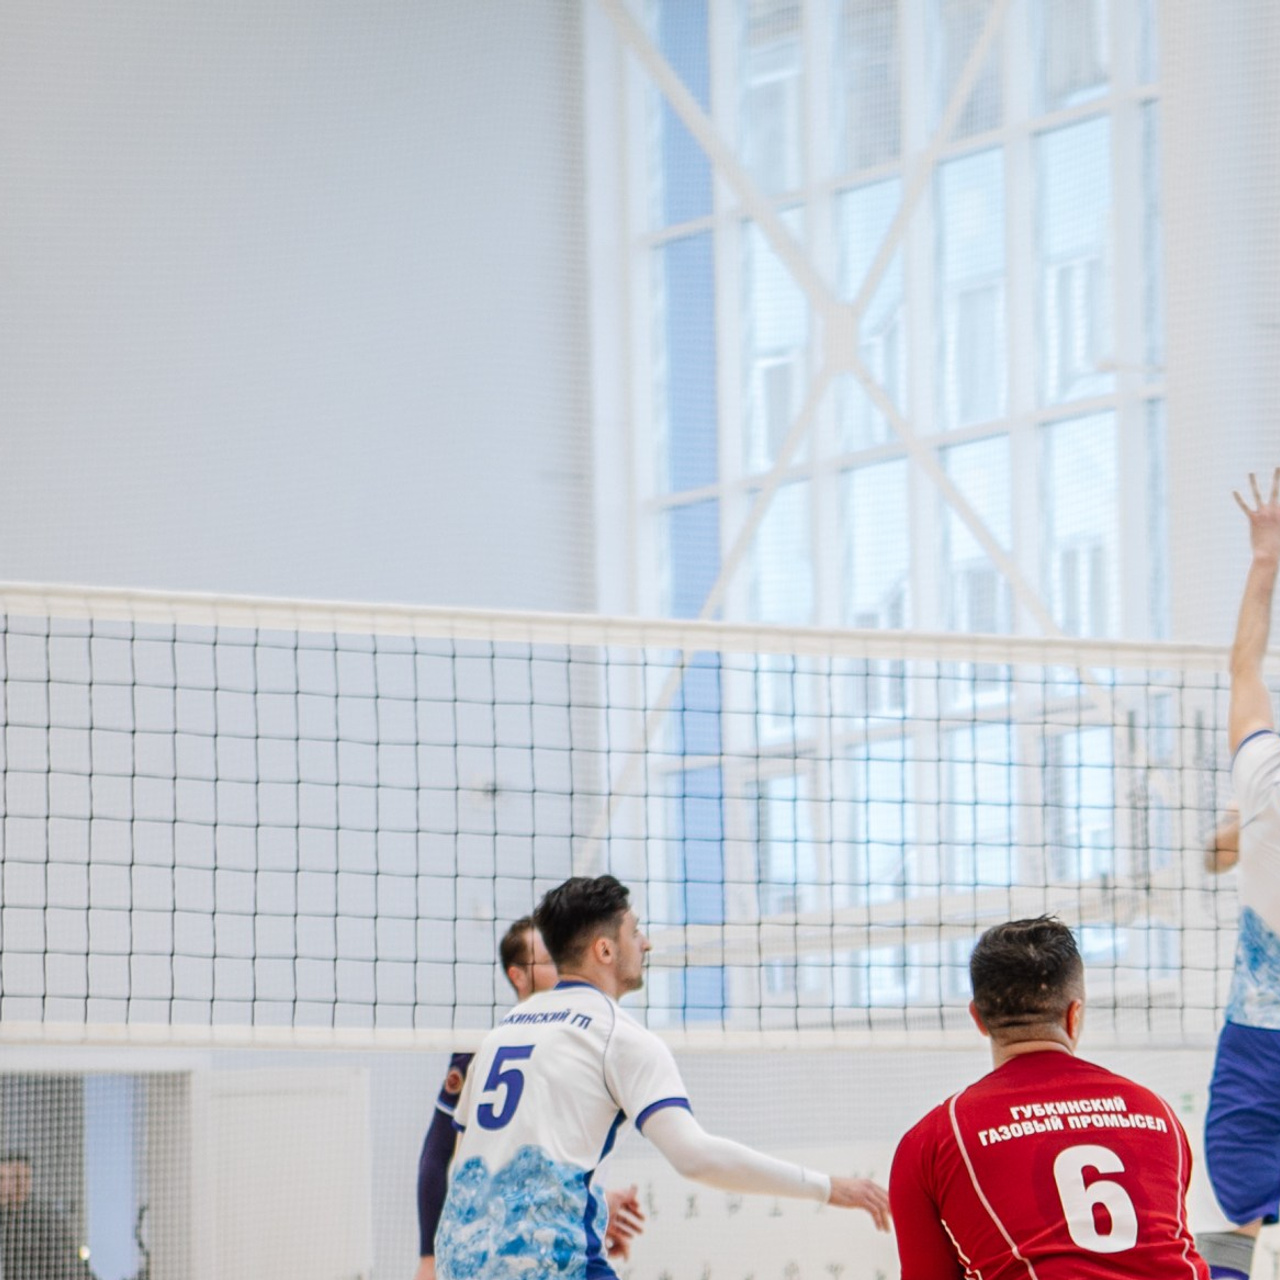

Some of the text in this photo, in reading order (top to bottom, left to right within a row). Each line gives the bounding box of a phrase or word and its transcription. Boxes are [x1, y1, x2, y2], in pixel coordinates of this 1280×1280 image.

[570, 1013, 593, 1030] ГП
[476, 1043, 536, 1132] 5
[1009, 1096, 1128, 1121] ГУБКИНСКИЙ
[977, 1113, 1169, 1147] ГАЗОВЫЙ ПРОМЫСЕЛ
[1053, 1144, 1139, 1254] 6
